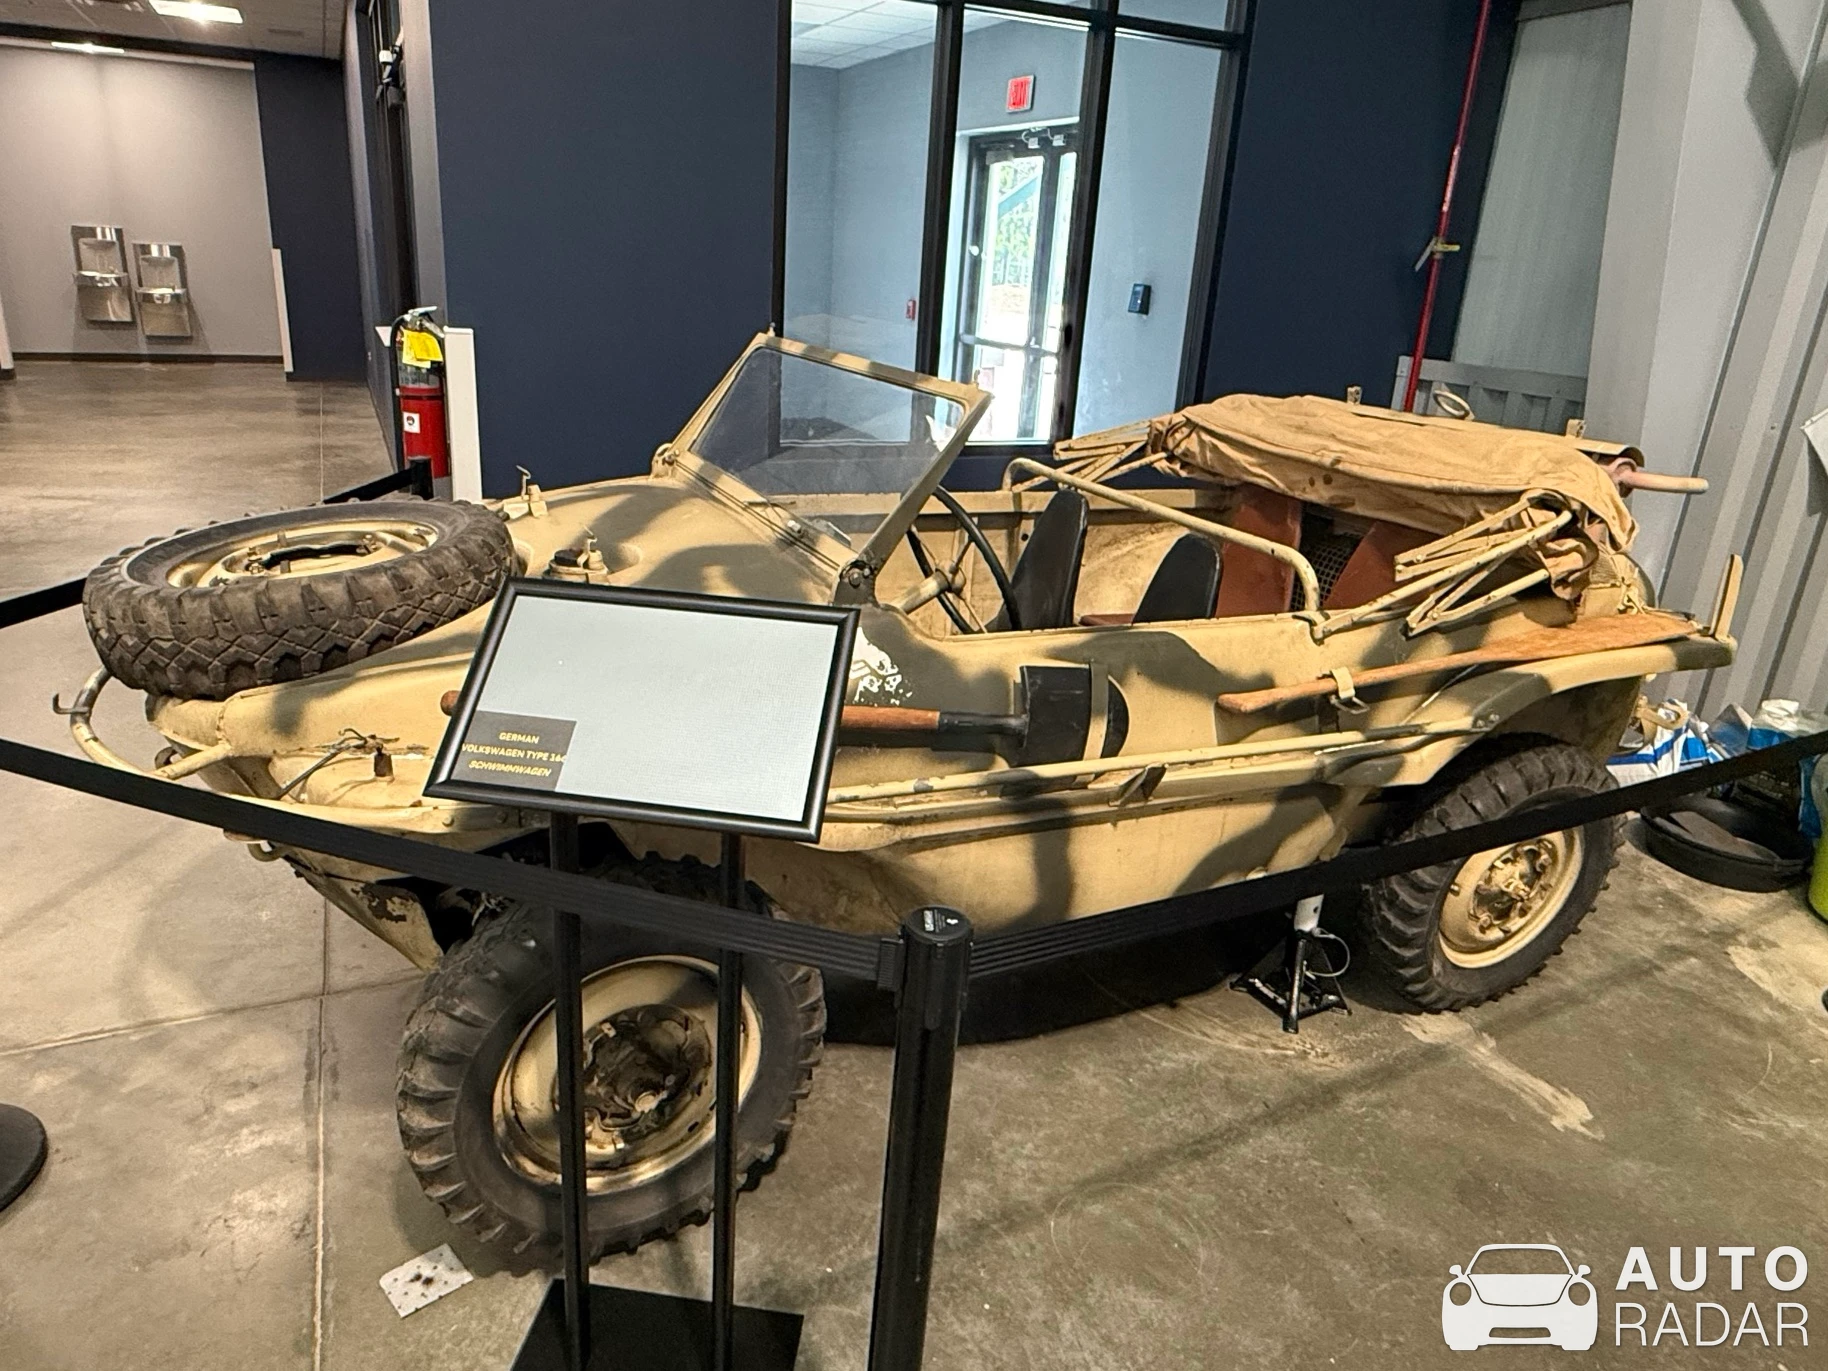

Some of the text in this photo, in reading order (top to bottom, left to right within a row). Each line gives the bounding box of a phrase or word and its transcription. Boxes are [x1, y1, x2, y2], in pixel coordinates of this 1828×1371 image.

[499, 732, 540, 744] GERMAN
[462, 743, 524, 759] VOLKSWAGEN
[526, 750, 549, 762] TYPE
[468, 760, 552, 777] SCHWIMMWAGEN
